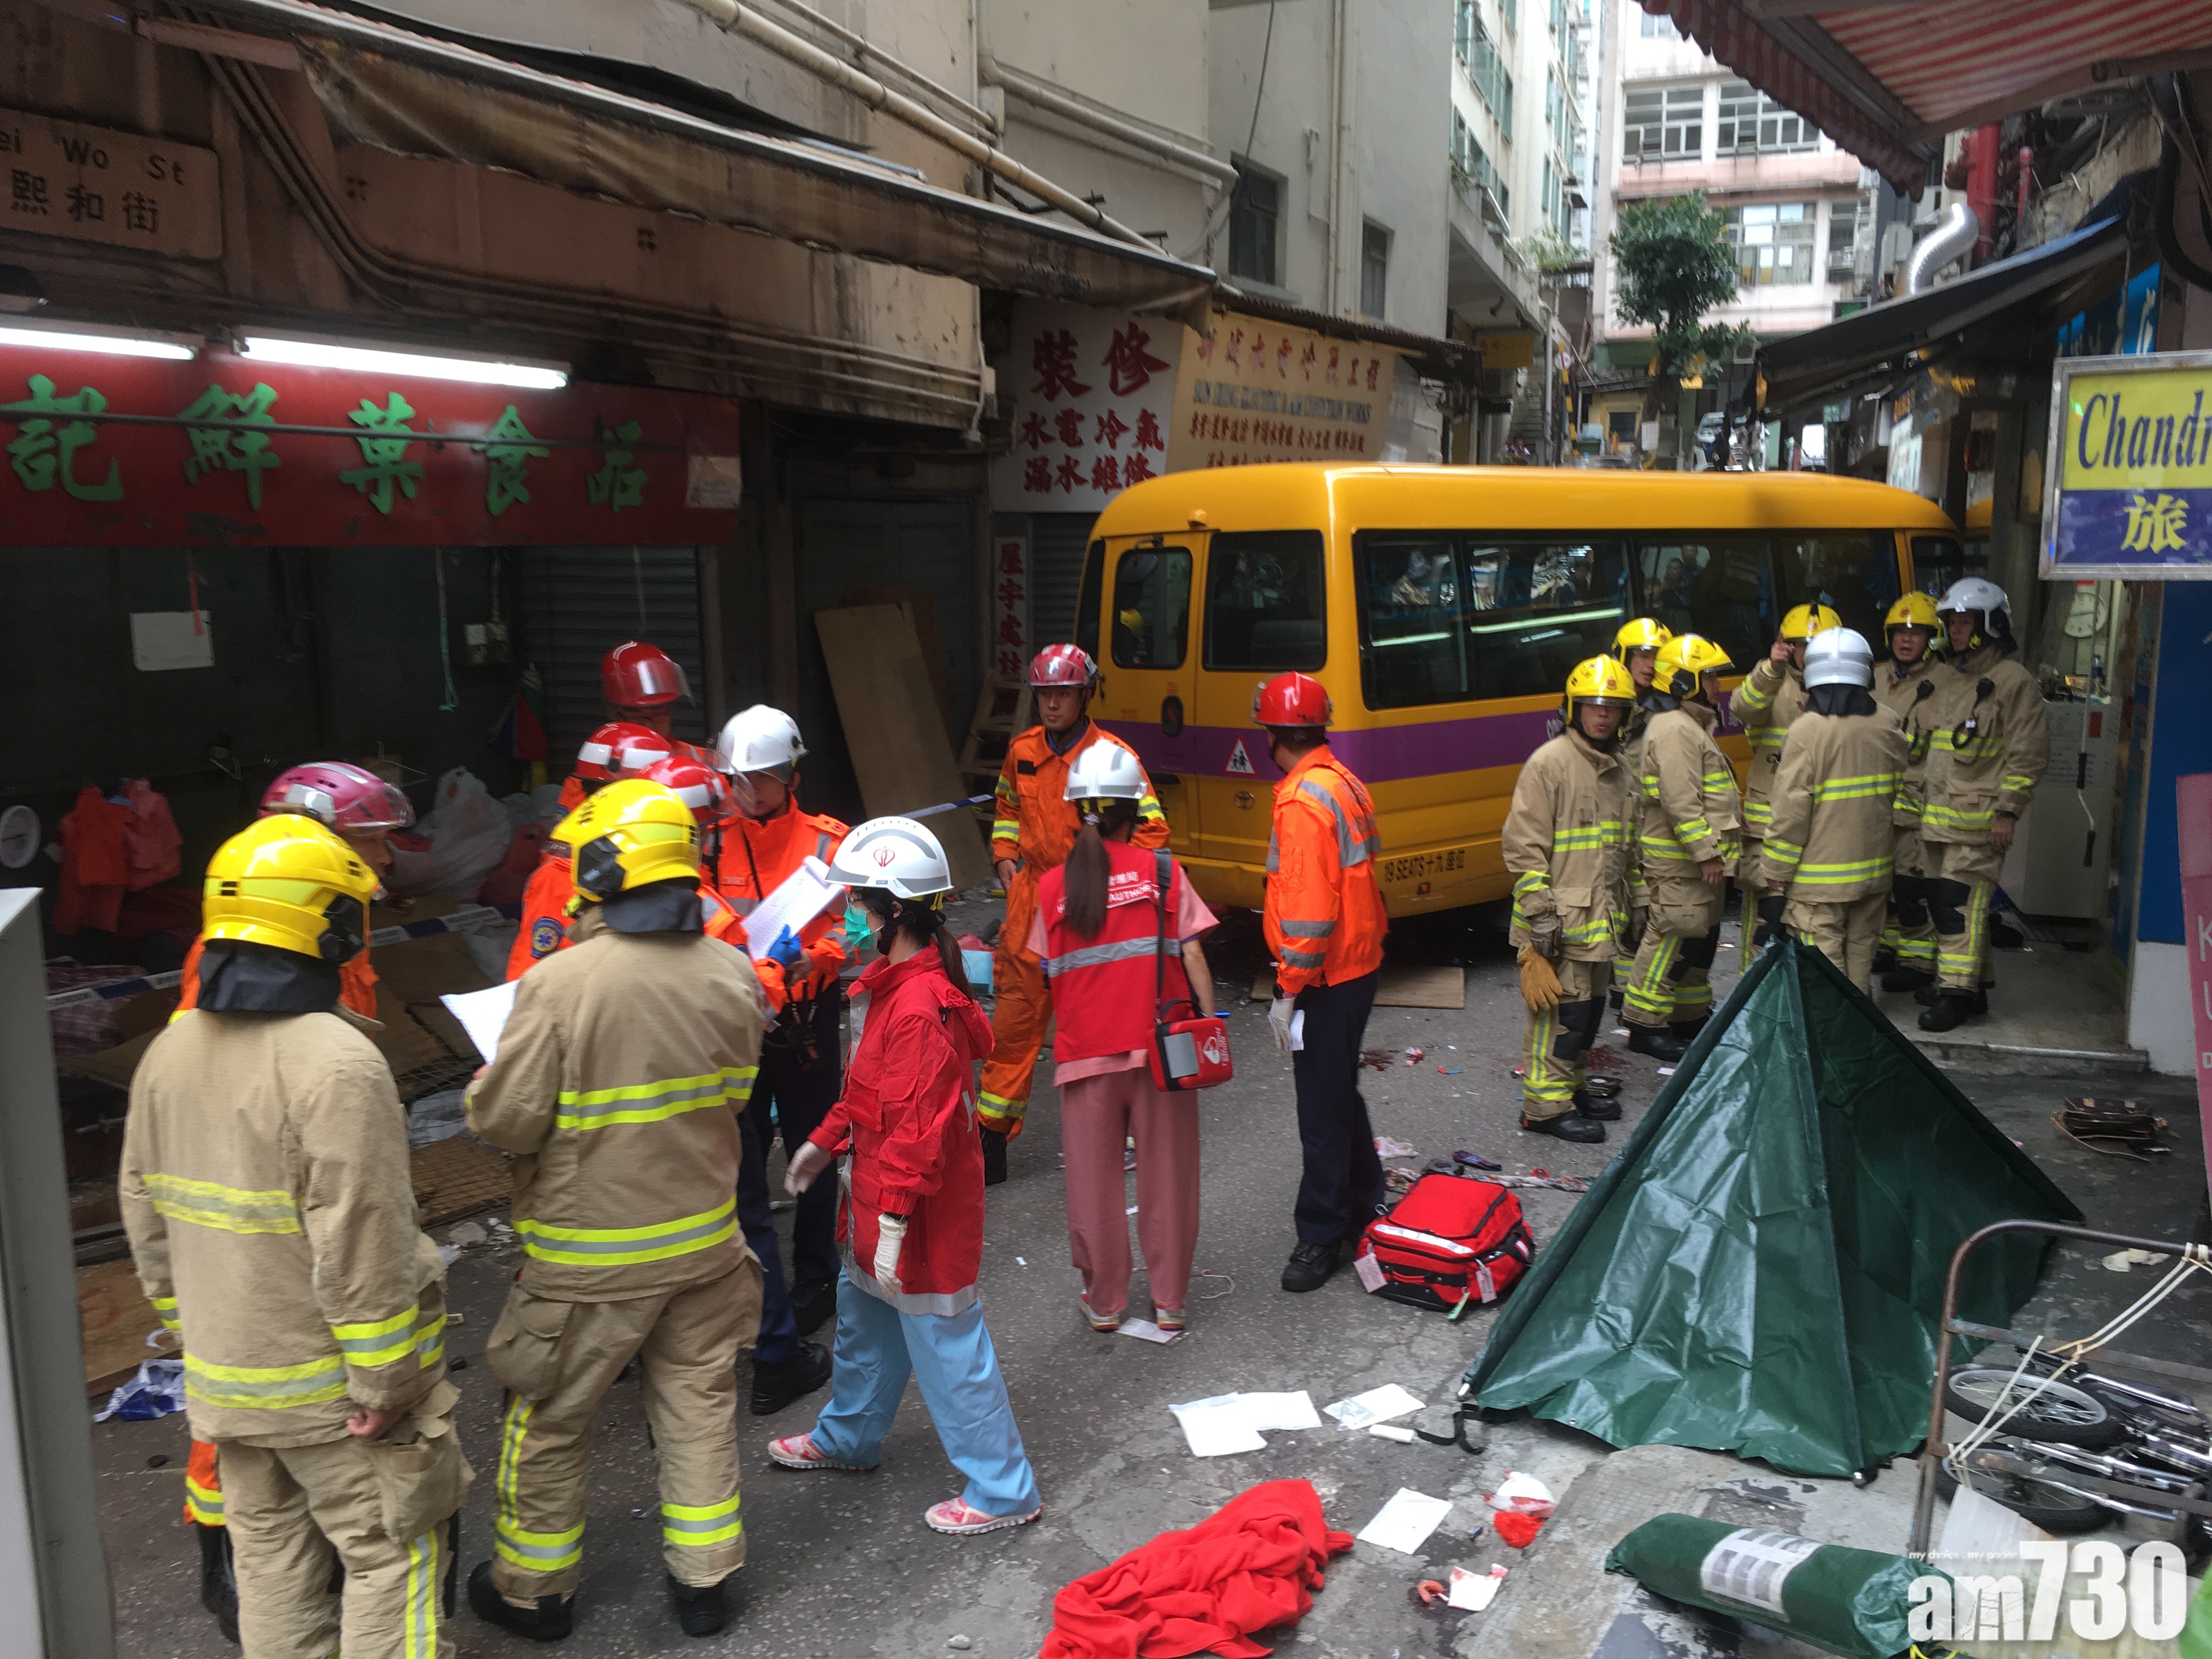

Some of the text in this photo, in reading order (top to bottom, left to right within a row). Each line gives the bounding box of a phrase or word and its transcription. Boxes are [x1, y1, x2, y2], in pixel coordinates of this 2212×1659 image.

[61, 137, 109, 170] Wo
[145, 154, 185, 187] St
[10, 168, 159, 235] 熙和街
[1030, 321, 1171, 403] 裝修
[1021, 408, 1164, 453] 水電冷氣
[2121, 493, 2190, 554] 旅
